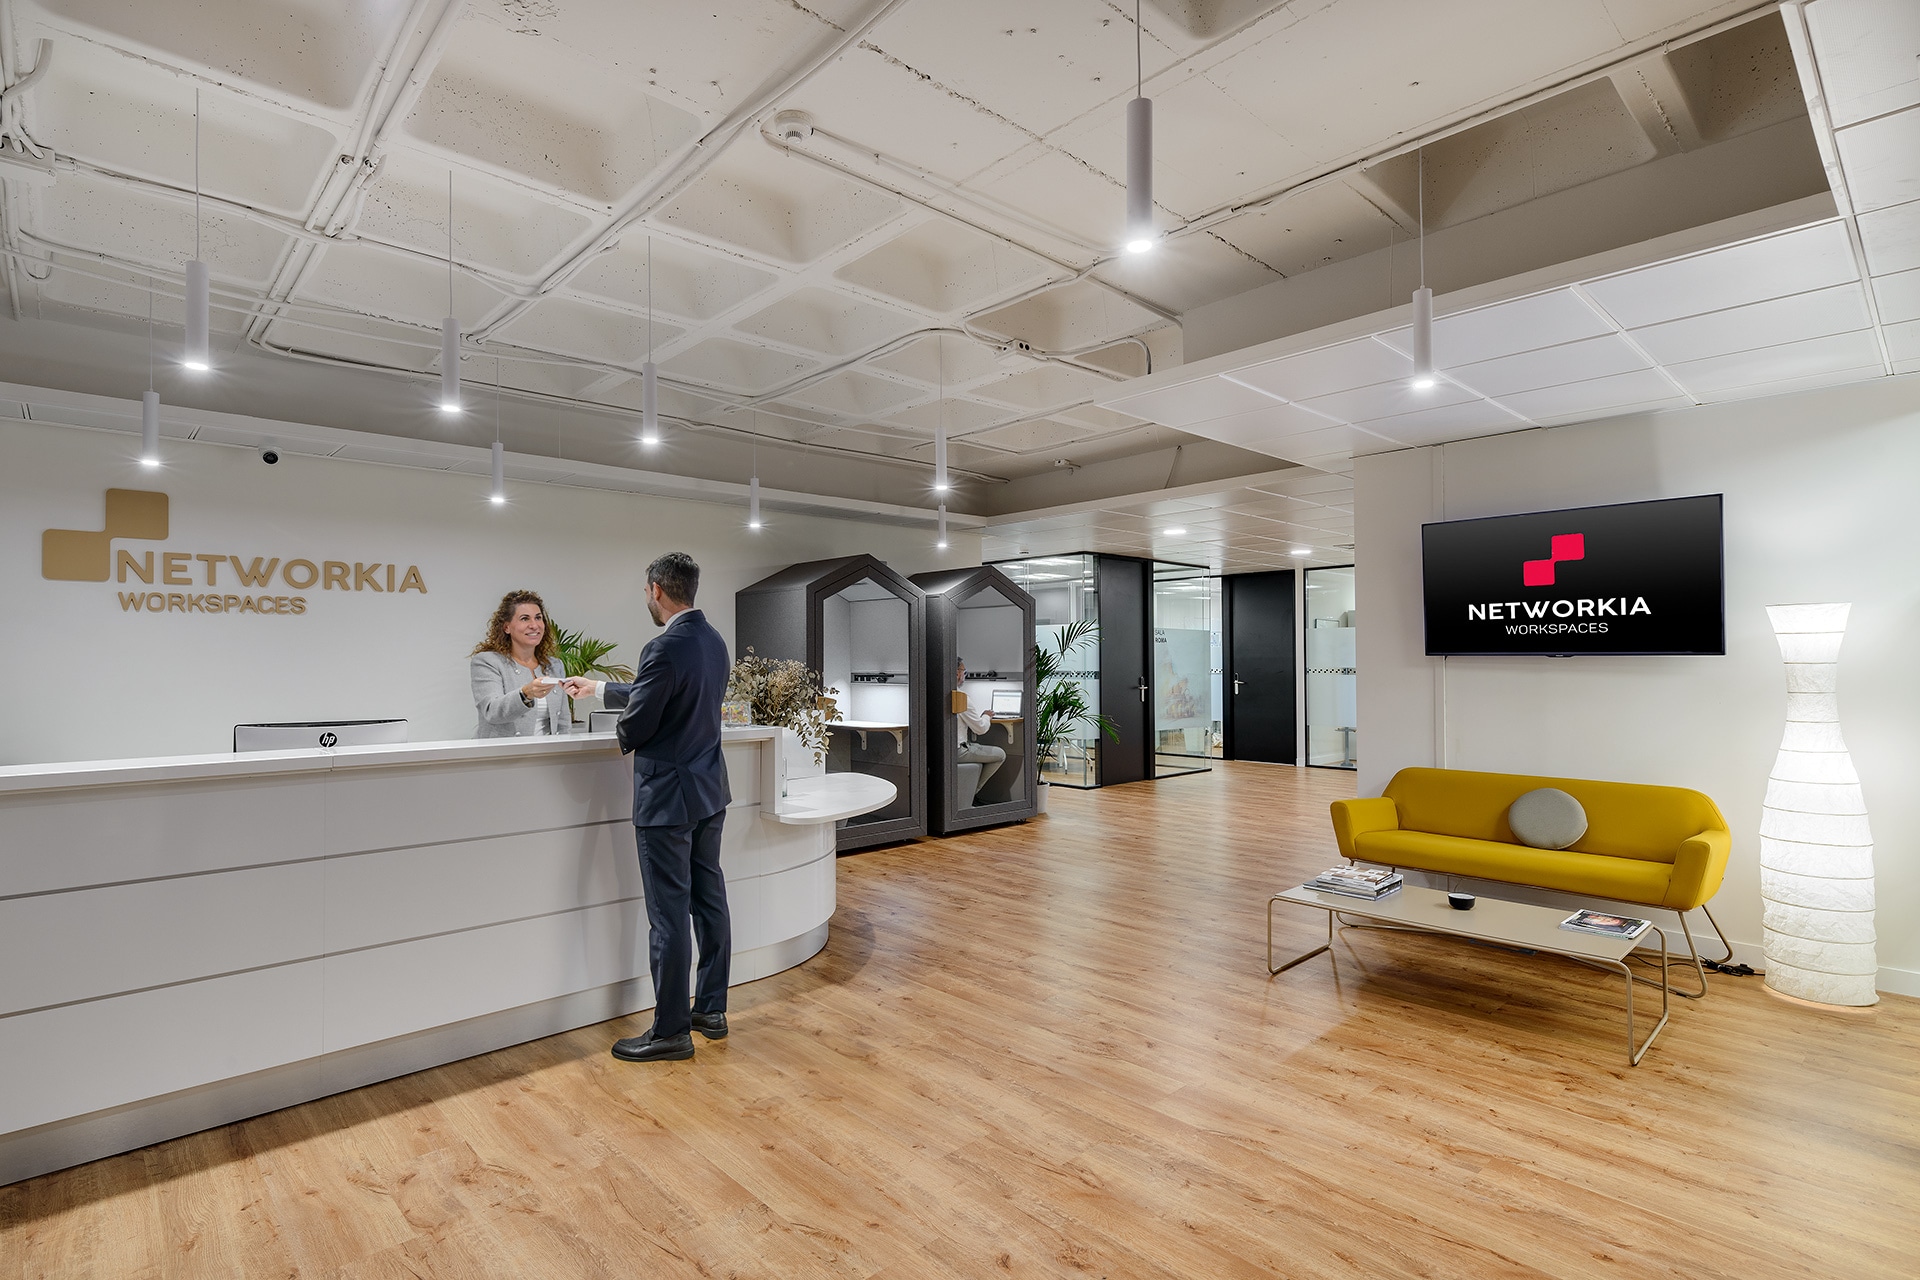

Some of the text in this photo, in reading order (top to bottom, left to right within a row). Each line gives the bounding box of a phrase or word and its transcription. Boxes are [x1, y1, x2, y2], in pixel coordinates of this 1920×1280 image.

[117, 550, 428, 594] NETWORKIA
[117, 591, 307, 615] WORKSPACES
[1468, 596, 1652, 621] NETWORKIA
[1505, 622, 1609, 635] WORKSPACES
[320, 732, 337, 748] hp
